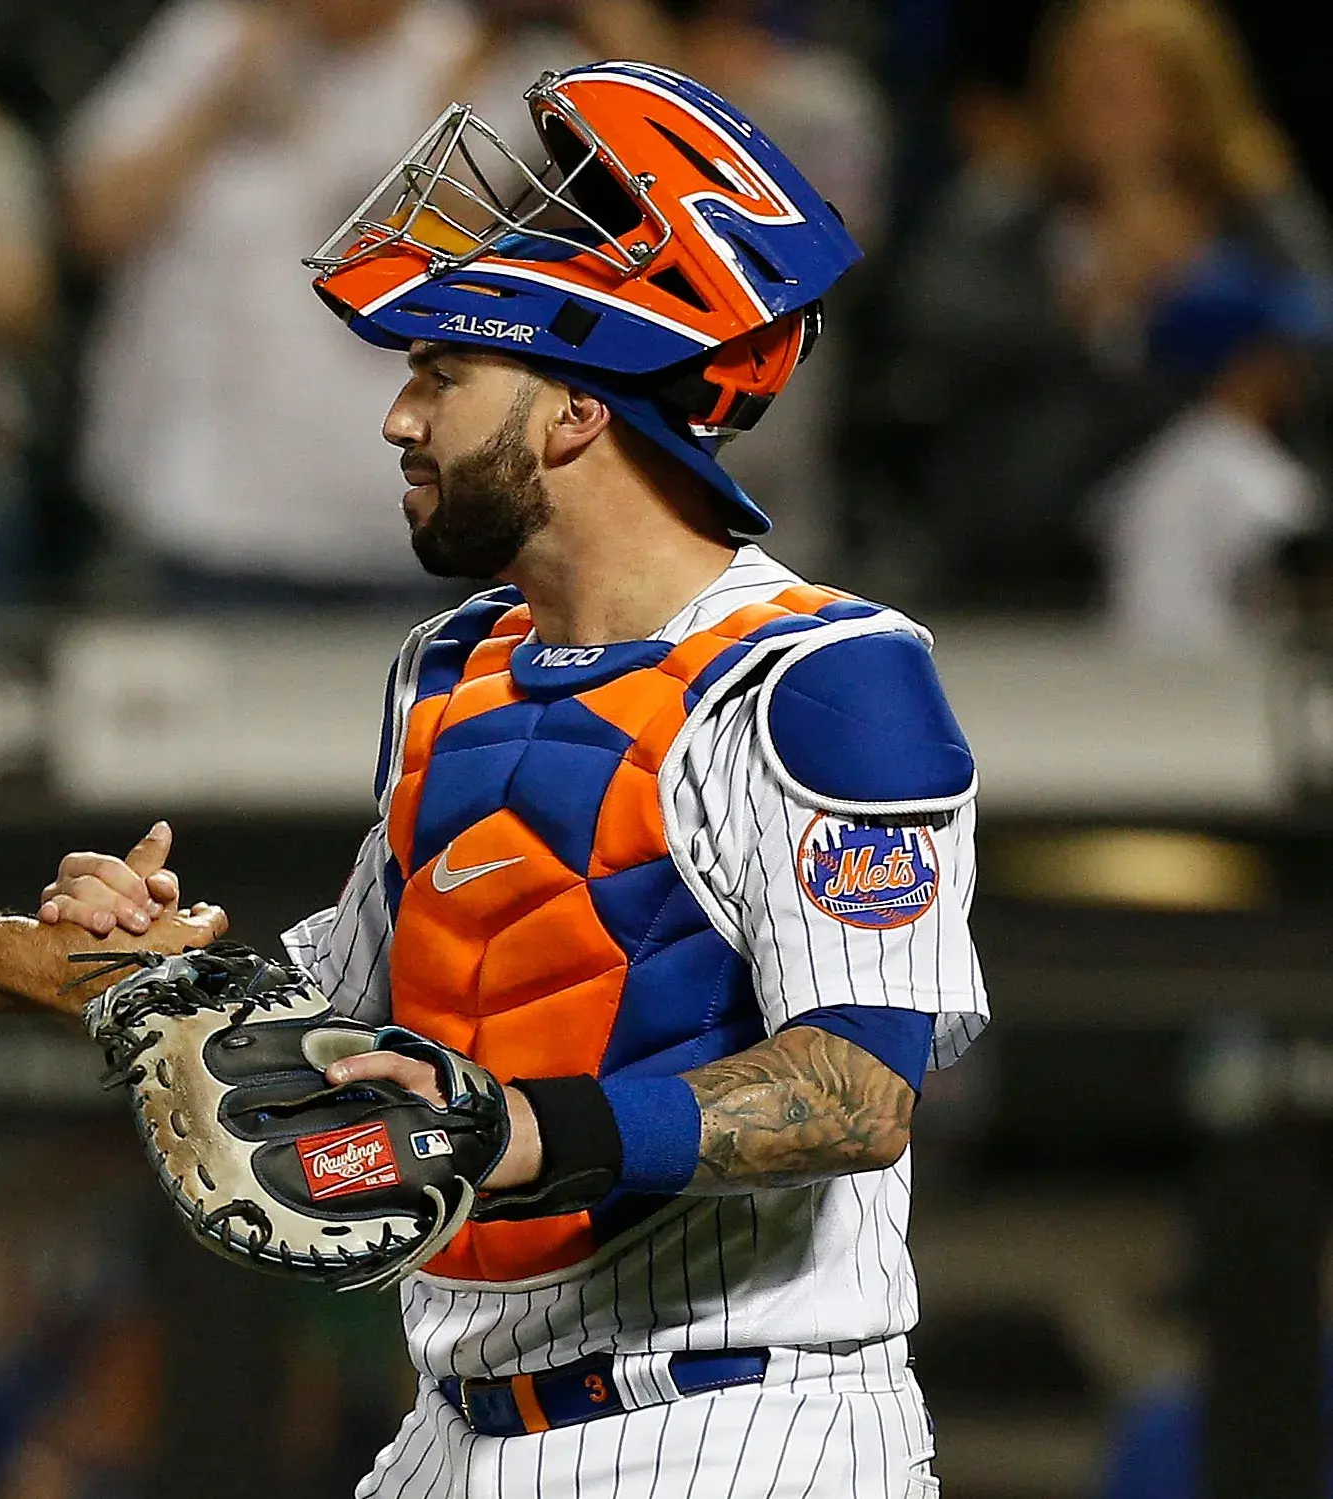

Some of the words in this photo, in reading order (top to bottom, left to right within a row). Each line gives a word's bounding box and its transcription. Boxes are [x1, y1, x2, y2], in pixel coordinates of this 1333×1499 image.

[438, 313, 533, 344] ALL-STAR
[531, 647, 605, 667] NIDO
[825, 846, 915, 897] Mets
[312, 1140, 384, 1178] Rawlings
[584, 1374, 608, 1403] 3
